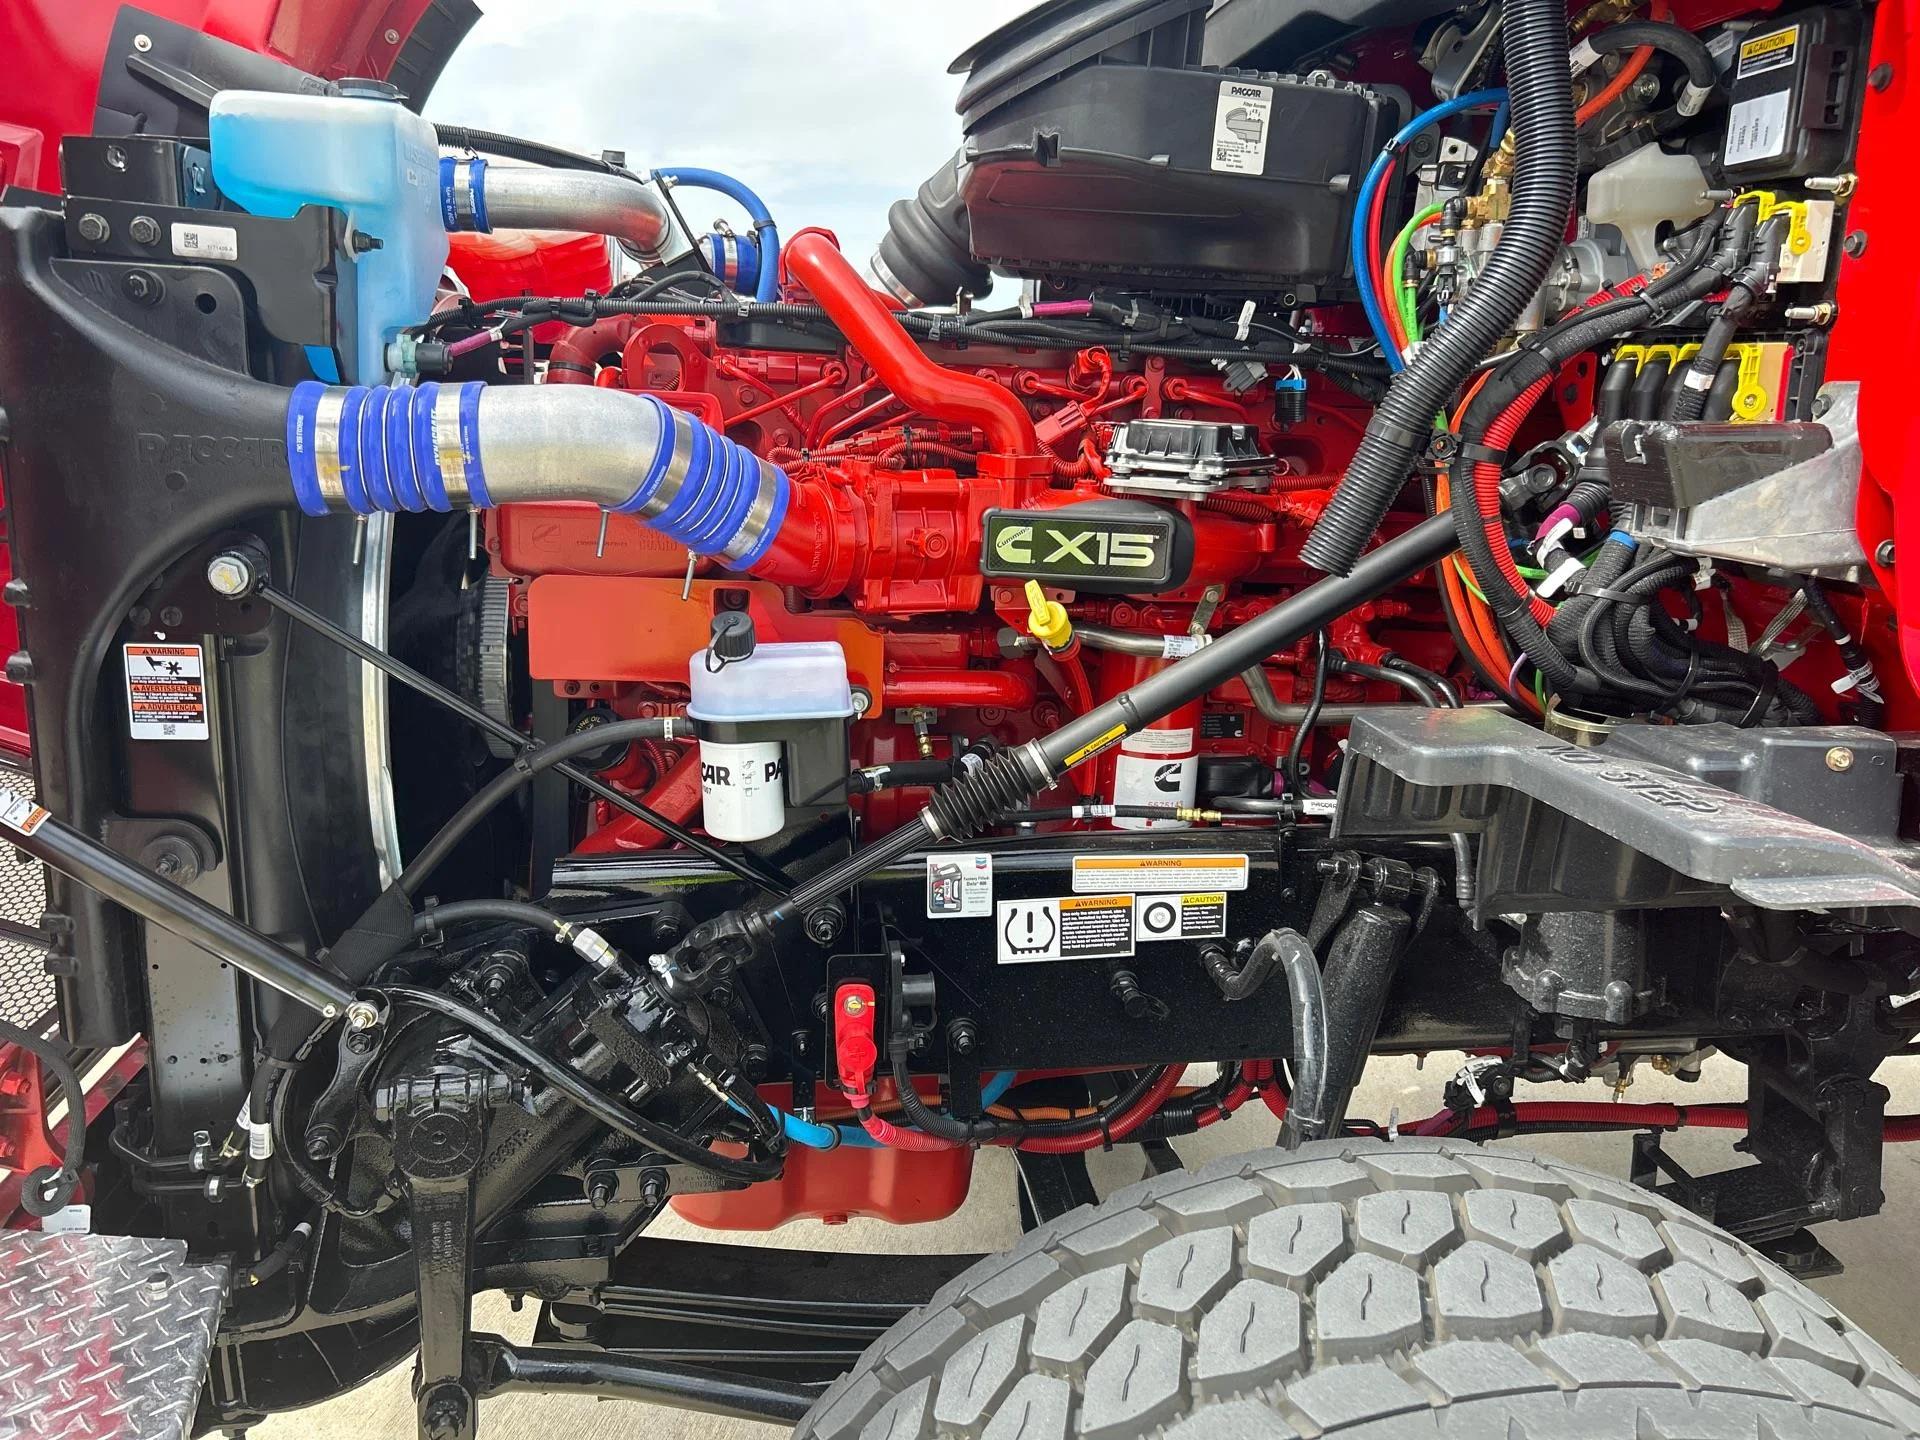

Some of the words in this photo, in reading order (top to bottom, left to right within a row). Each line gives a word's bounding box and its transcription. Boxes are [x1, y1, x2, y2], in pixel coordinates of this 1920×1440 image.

[1231, 86, 1262, 98] PACCAR
[1599, 770, 1720, 813] STEP
[1189, 895, 1224, 903] CAUTION
